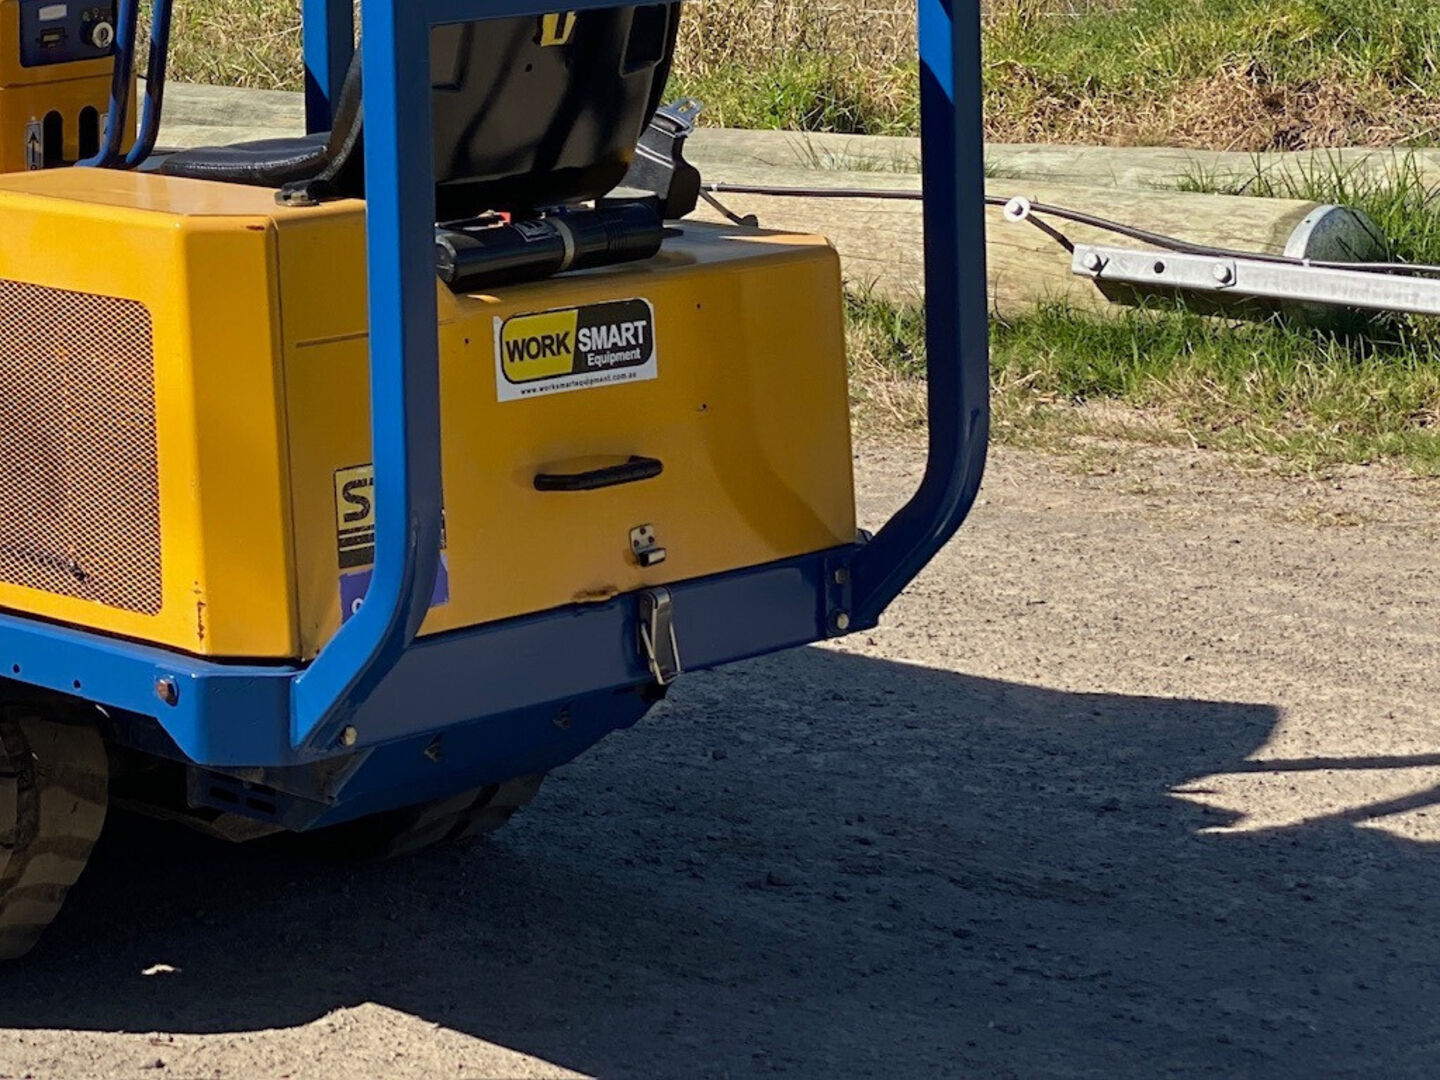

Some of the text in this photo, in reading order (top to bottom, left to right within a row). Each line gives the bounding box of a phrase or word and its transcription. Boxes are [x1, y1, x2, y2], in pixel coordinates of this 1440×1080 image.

[505, 320, 647, 363] WORK SMART
[587, 347, 641, 367] Equipment
